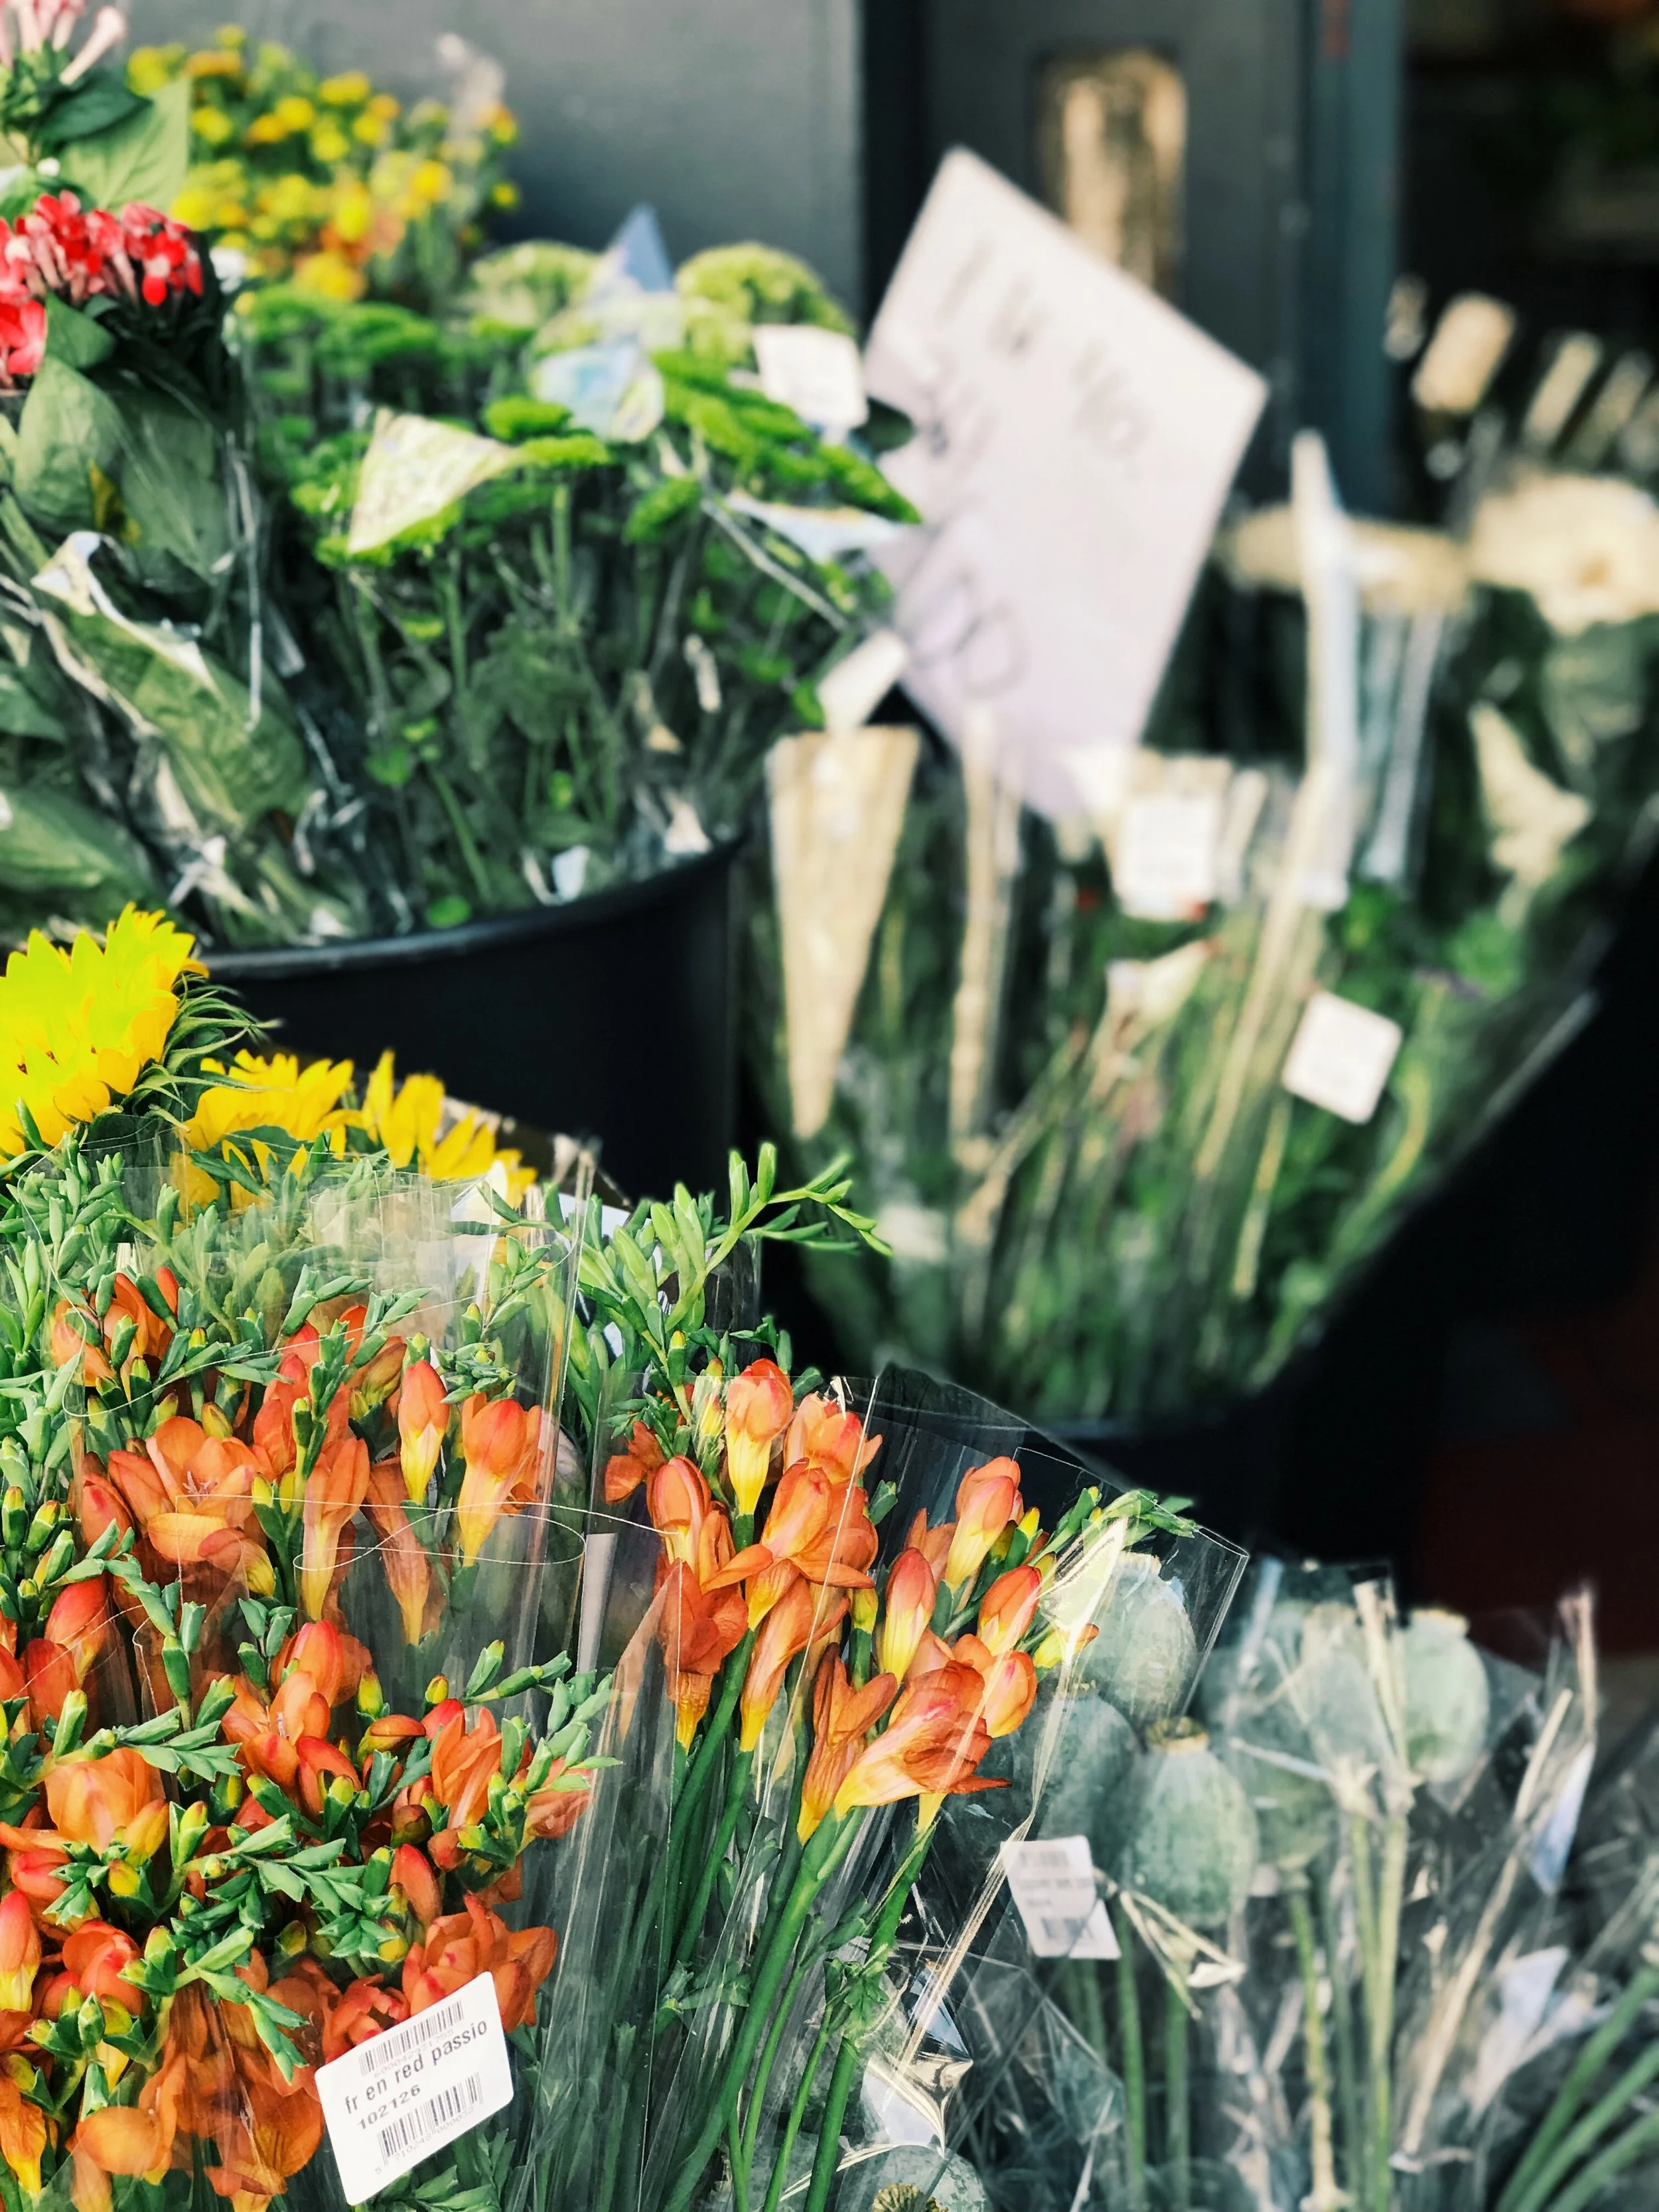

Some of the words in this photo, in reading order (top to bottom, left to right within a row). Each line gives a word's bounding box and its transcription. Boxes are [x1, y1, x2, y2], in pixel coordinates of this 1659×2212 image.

[344, 2095, 358, 2114] fr
[366, 2079, 387, 2101] en
[395, 2053, 423, 2084] red
[431, 2020, 487, 2065] passio
[358, 2084, 421, 2130] 102126
